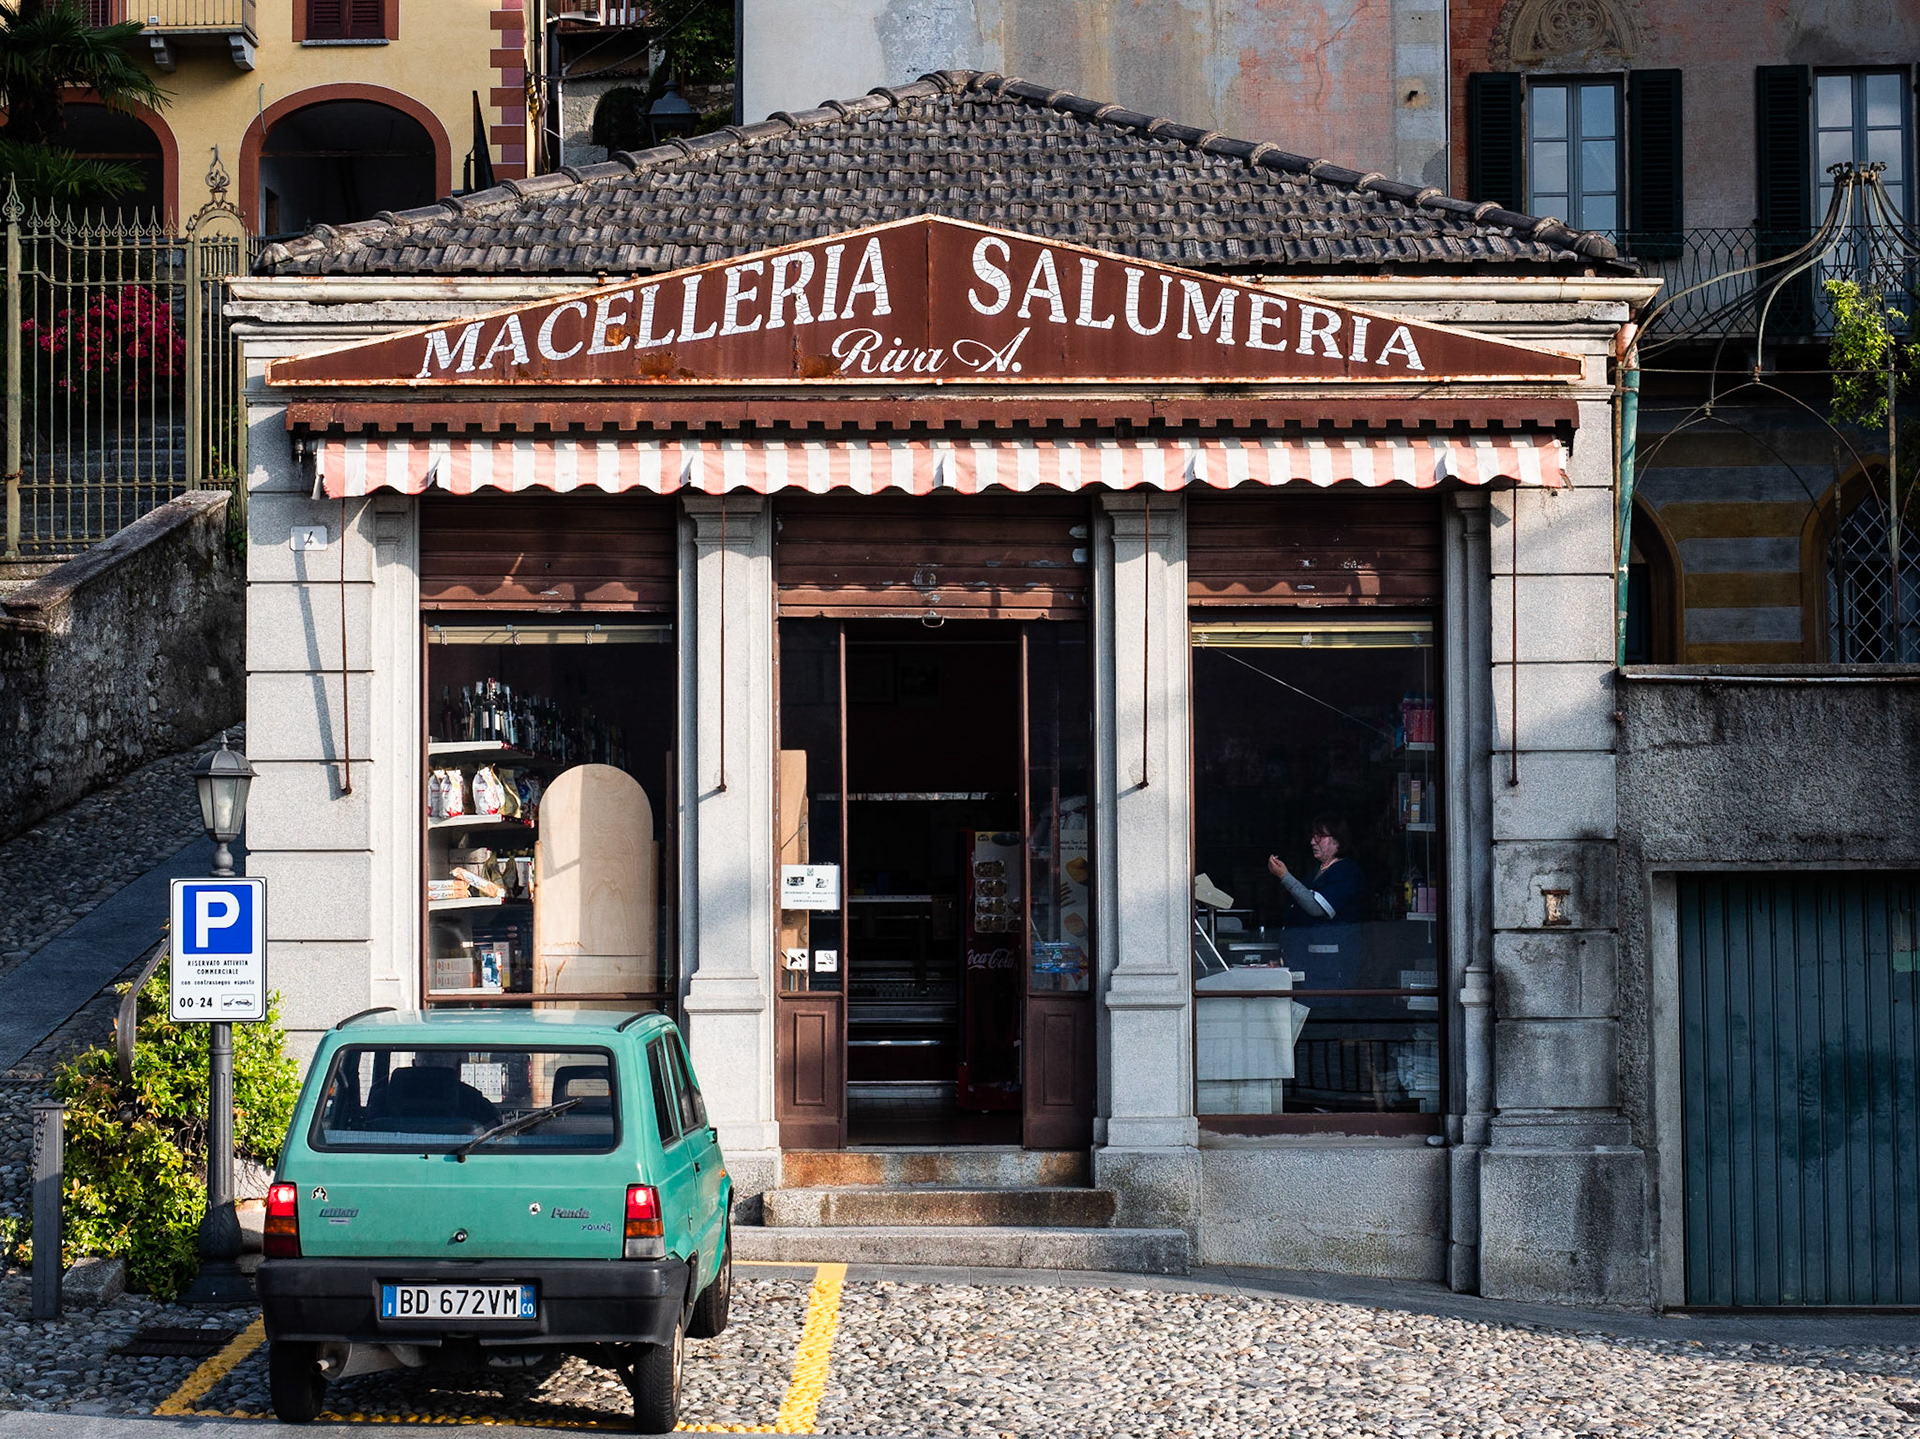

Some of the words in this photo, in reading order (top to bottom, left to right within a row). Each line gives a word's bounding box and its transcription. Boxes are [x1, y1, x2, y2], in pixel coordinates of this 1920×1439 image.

[415, 236, 891, 379] MACELLERIA
[968, 235, 1426, 372] SALUMERIA
[830, 327, 949, 374] Riva
[952, 326, 1031, 373] A.
[195, 891, 240, 948] P
[551, 1207, 591, 1219] Panda
[581, 1221, 612, 1233] YOUNG
[399, 1289, 430, 1315] BD
[439, 1289, 518, 1315] 672VM
[521, 1302, 534, 1315] CO
